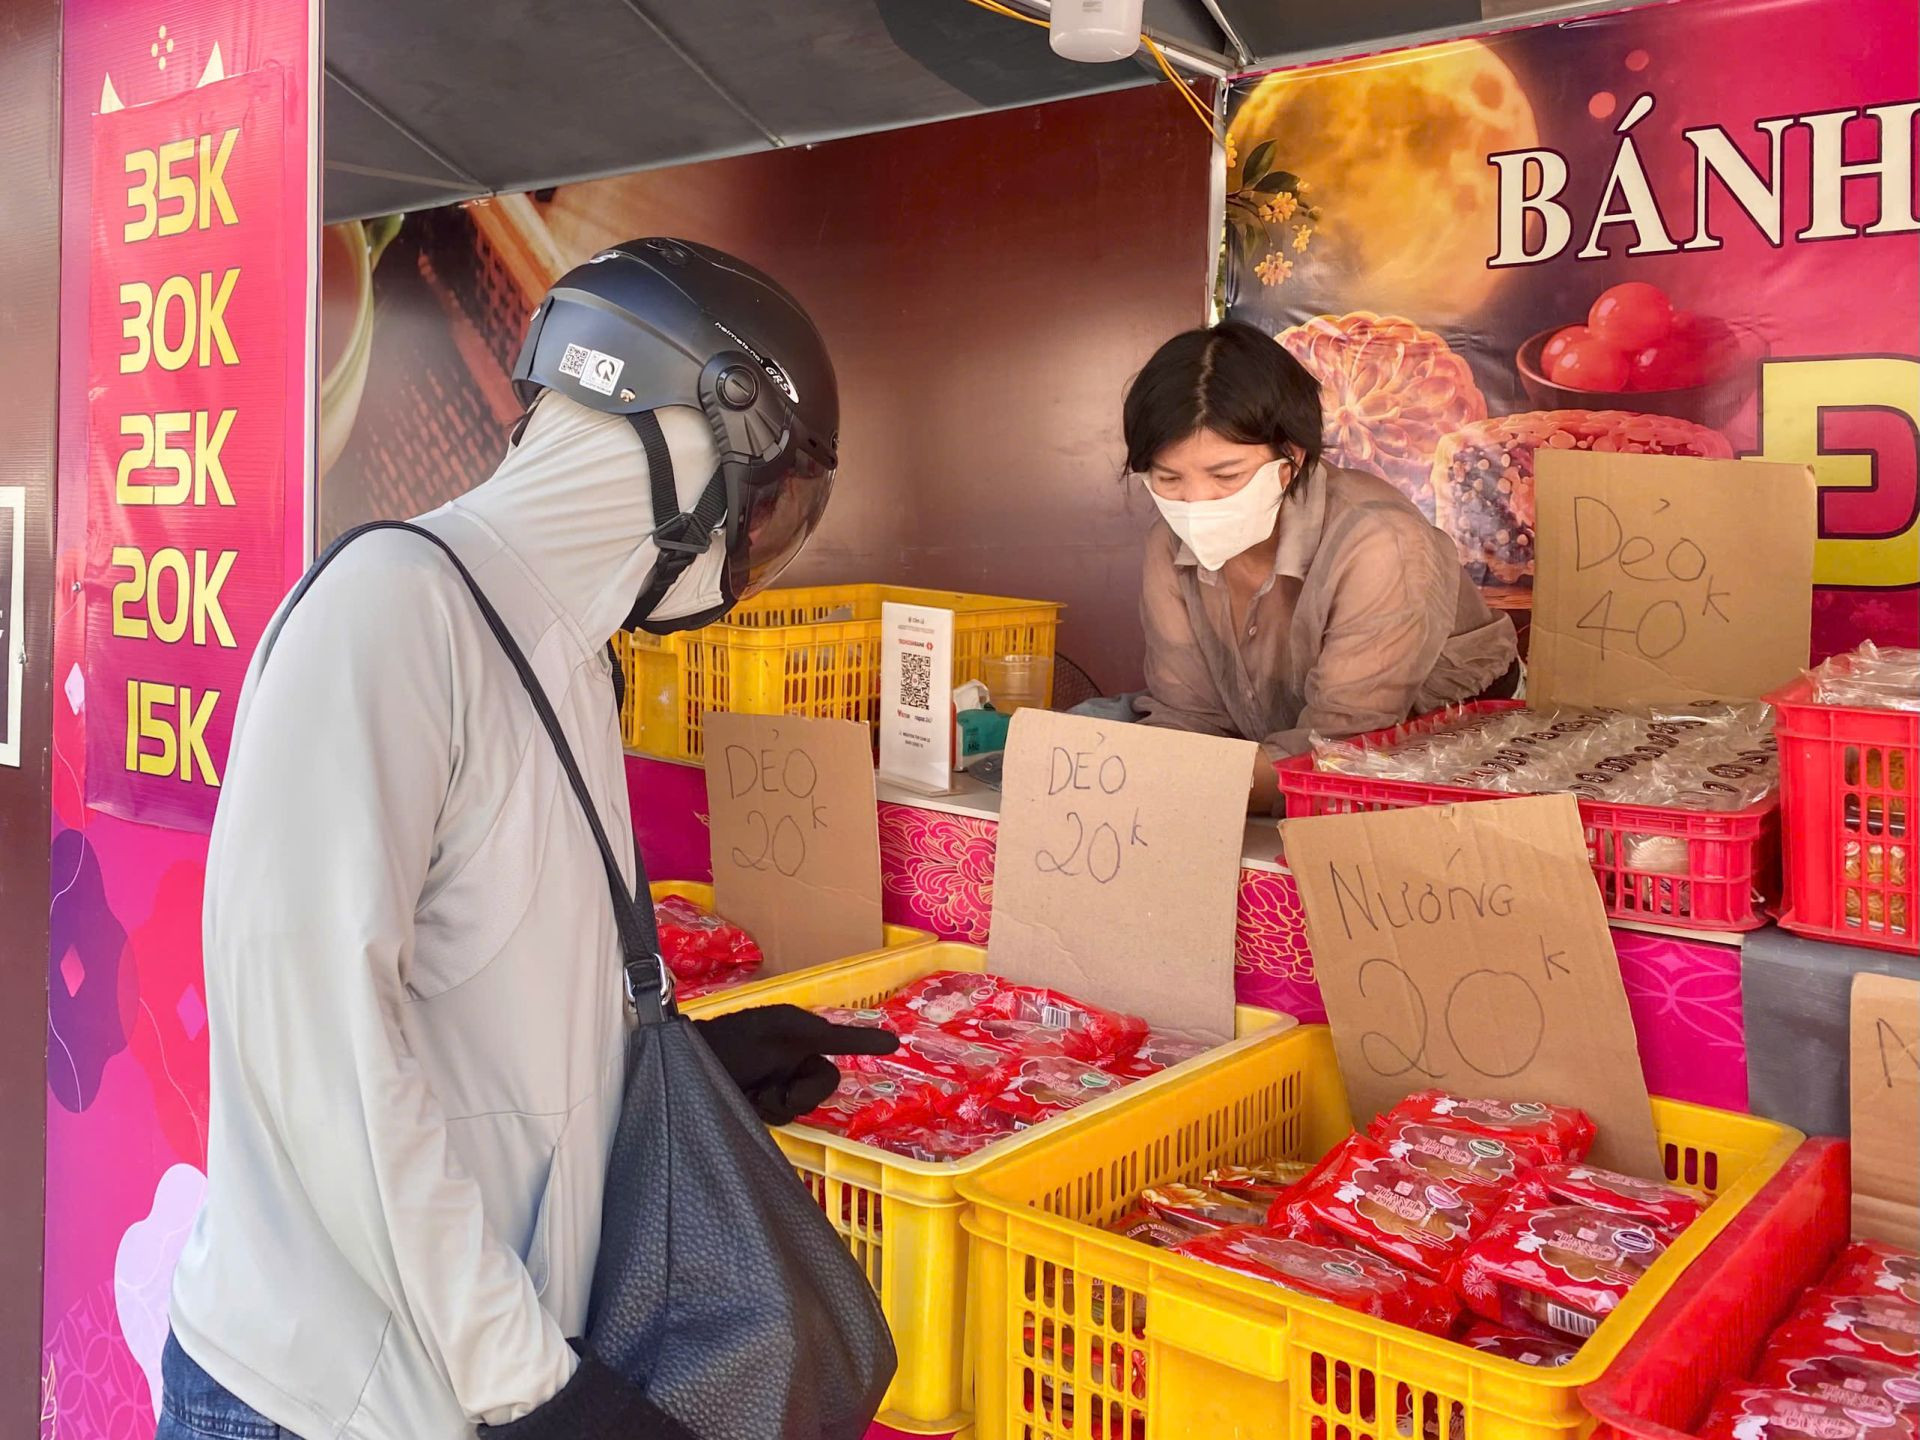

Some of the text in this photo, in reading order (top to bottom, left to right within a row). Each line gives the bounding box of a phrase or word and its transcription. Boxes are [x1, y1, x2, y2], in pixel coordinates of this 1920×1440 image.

[123, 127, 241, 244] 35K
[1487, 91, 1920, 269] BÁNH
[119, 266, 242, 375] 30K
[116, 408, 239, 507] 25K
[111, 546, 240, 649] 20K
[125, 679, 221, 788] 15K
[725, 728, 818, 800] DẺO
[1048, 731, 1127, 796] DẺO
